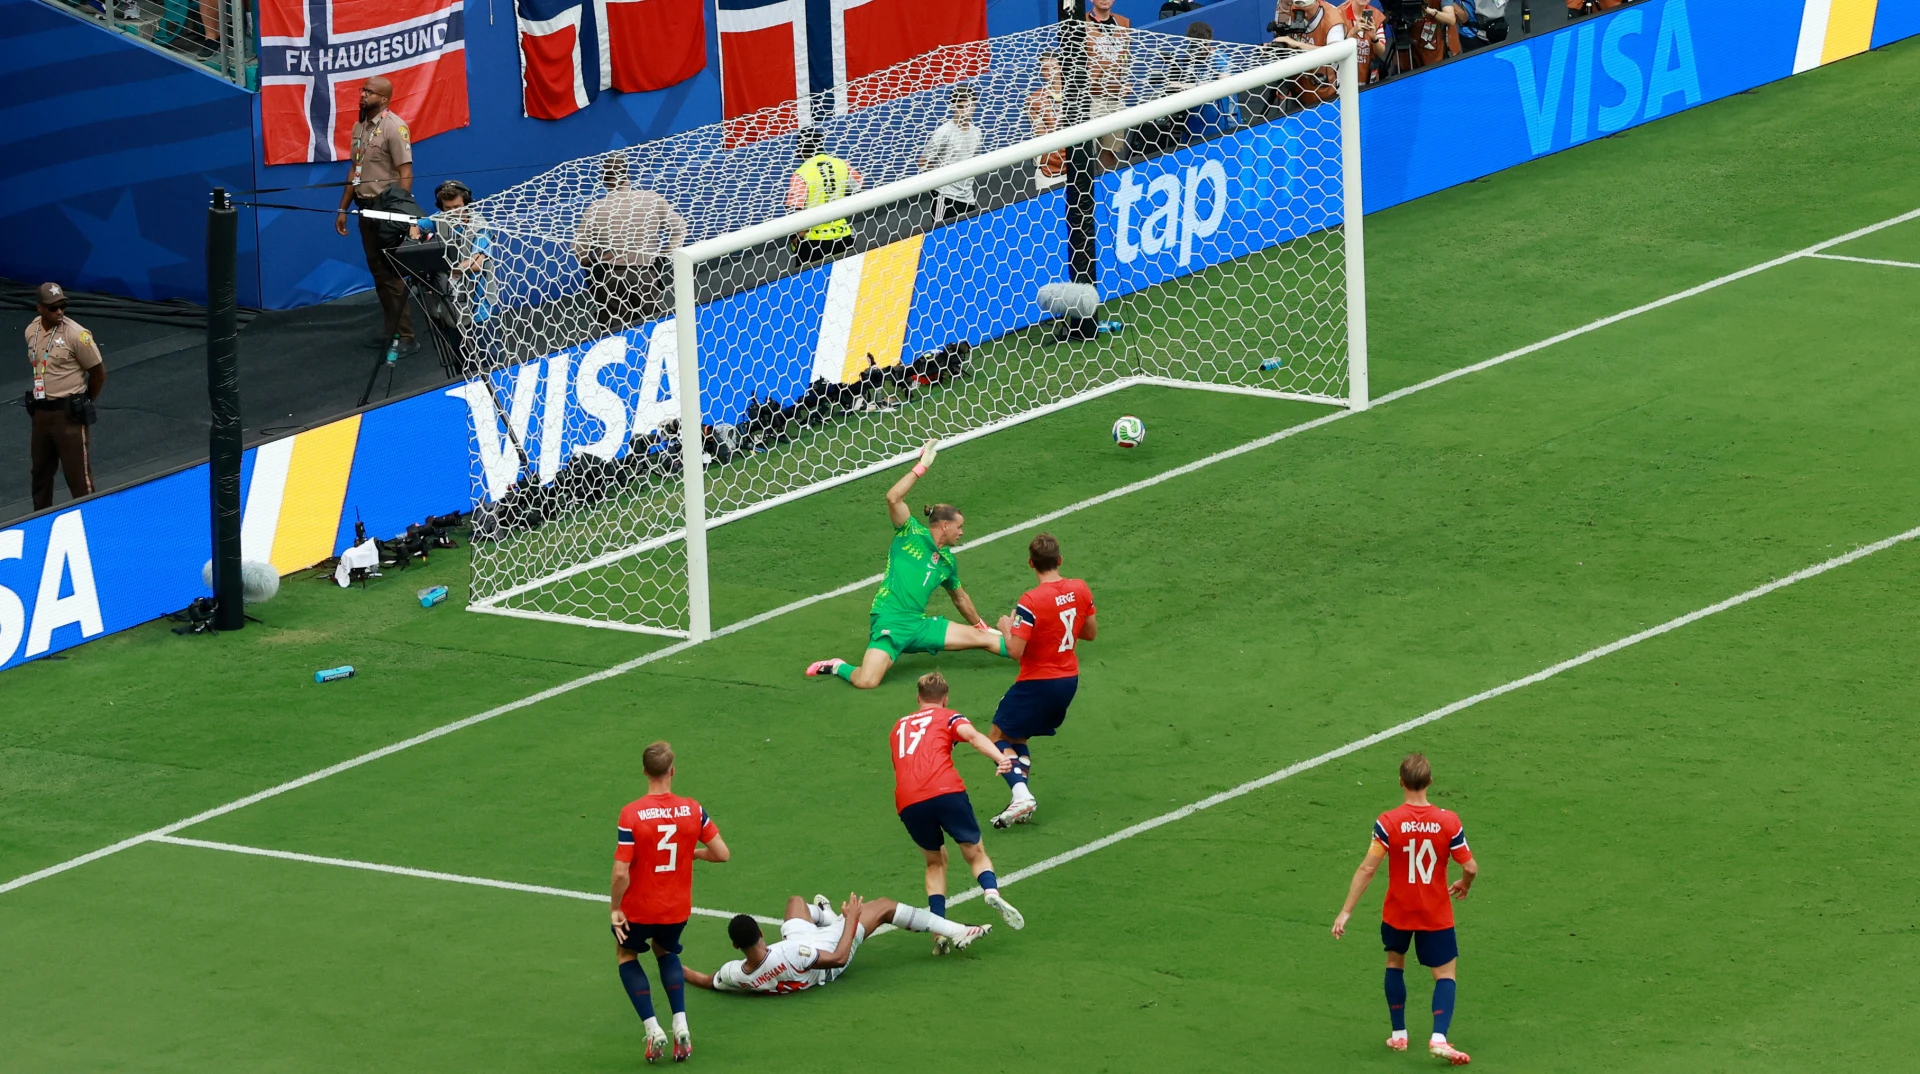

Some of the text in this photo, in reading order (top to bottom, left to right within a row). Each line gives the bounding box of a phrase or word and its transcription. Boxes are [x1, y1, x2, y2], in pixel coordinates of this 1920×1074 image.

[285, 23, 448, 72] FK HAUGESUND
[1494, 0, 1702, 156] VISA
[1111, 158, 1227, 267] tap
[445, 318, 682, 502] VISA
[1055, 591, 1076, 606] BERGE
[1057, 607, 1077, 653] 8
[896, 715, 933, 758] 17
[654, 824, 678, 873] 3
[1401, 821, 1441, 833] ØDEGAARD
[1402, 838, 1438, 885] 10
